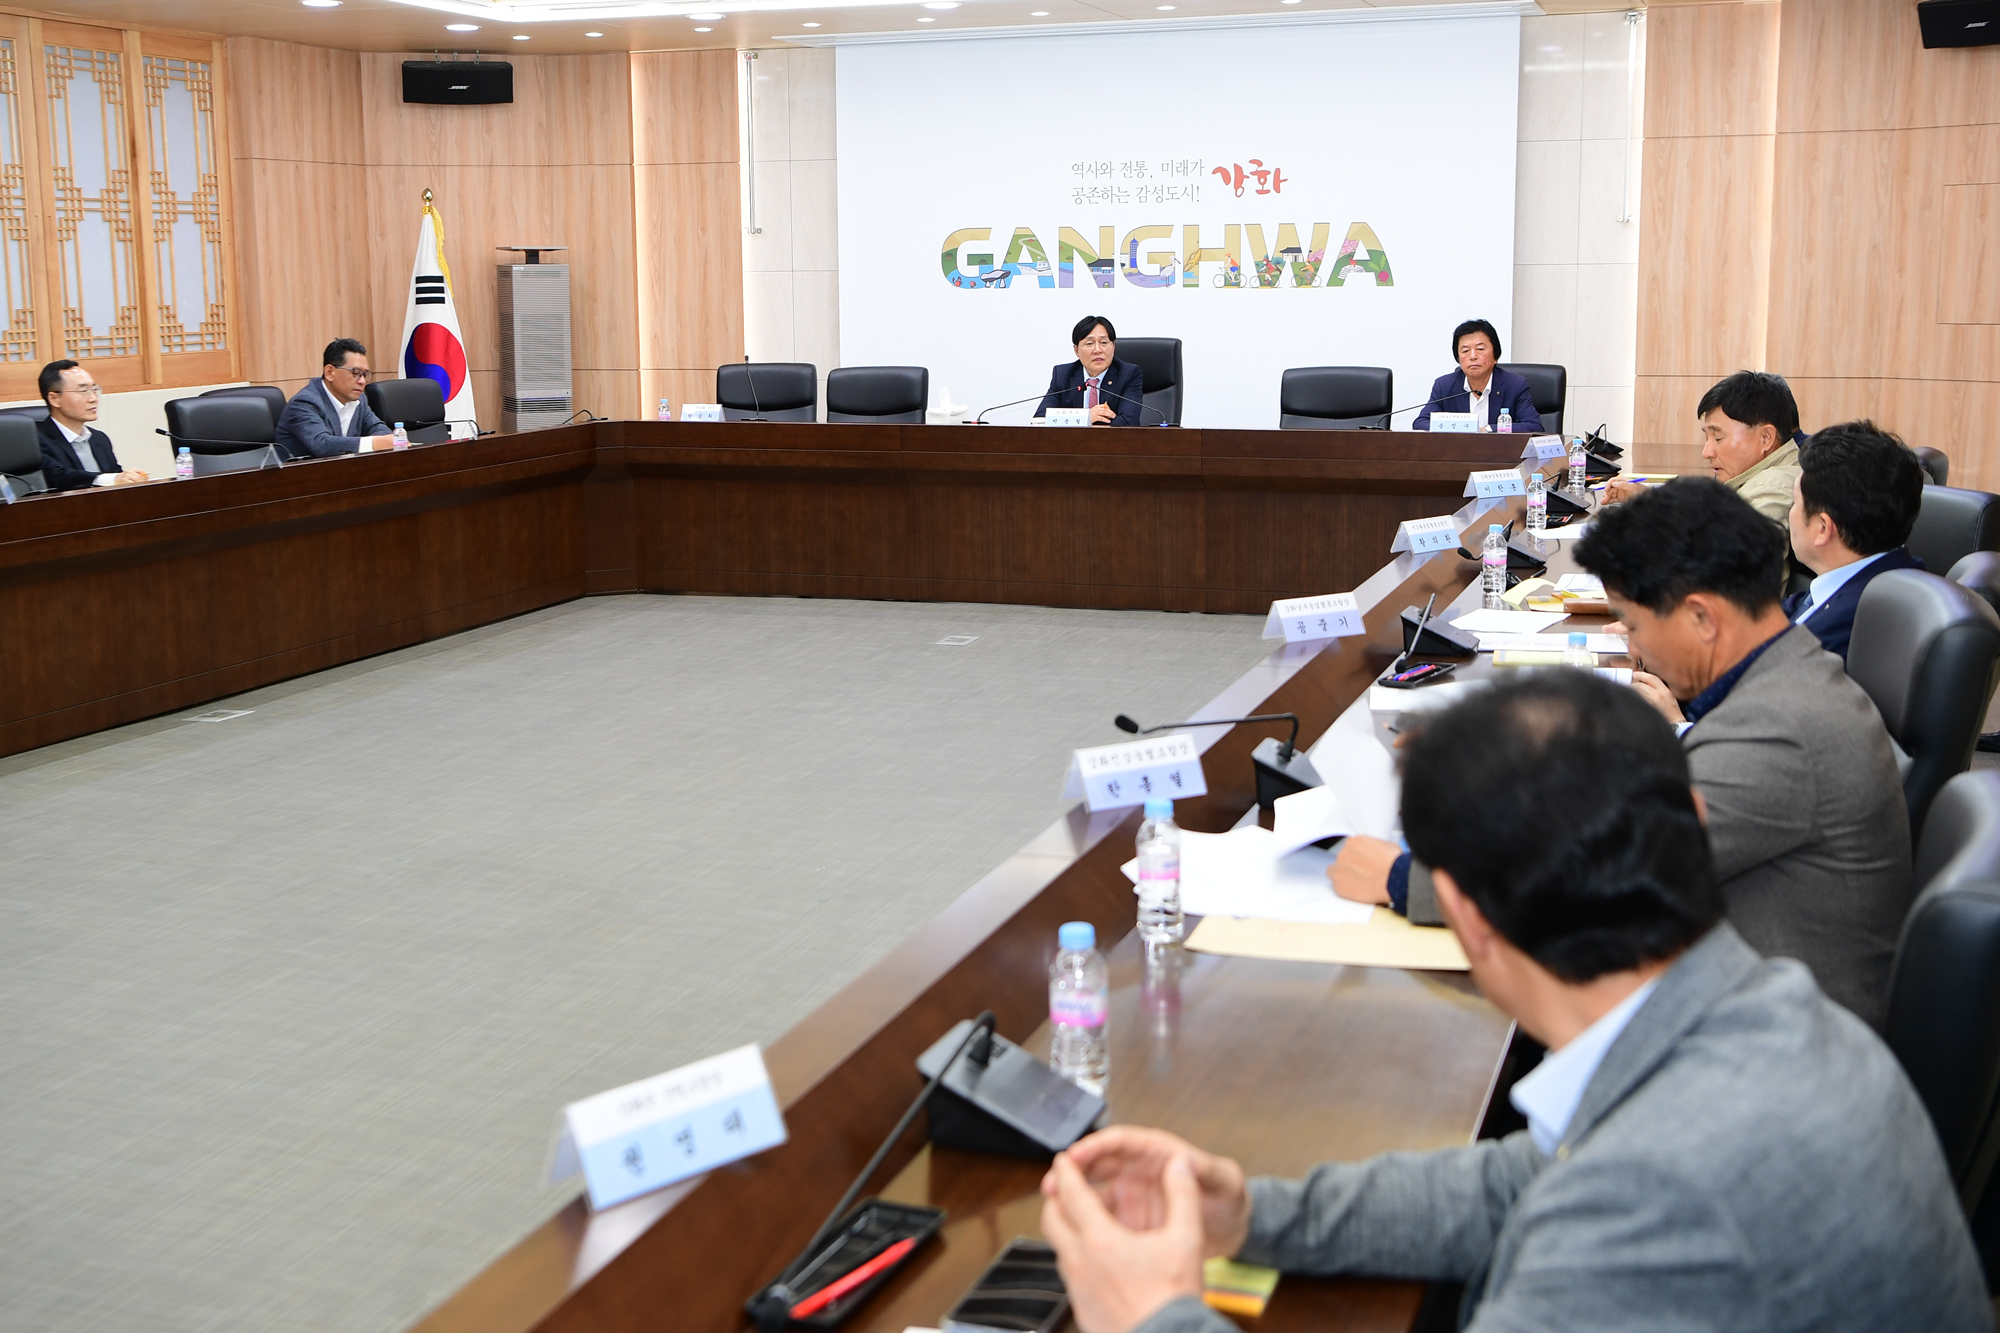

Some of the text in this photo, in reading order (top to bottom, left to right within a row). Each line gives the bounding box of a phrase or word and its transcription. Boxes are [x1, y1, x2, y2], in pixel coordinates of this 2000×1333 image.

[1071, 158, 1205, 179] 역사와 전통, 미래가
[1211, 158, 1288, 198] 강화
[1071, 184, 1200, 205] 공존하는 감성도시!
[941, 222, 1395, 289] GANGHWA
